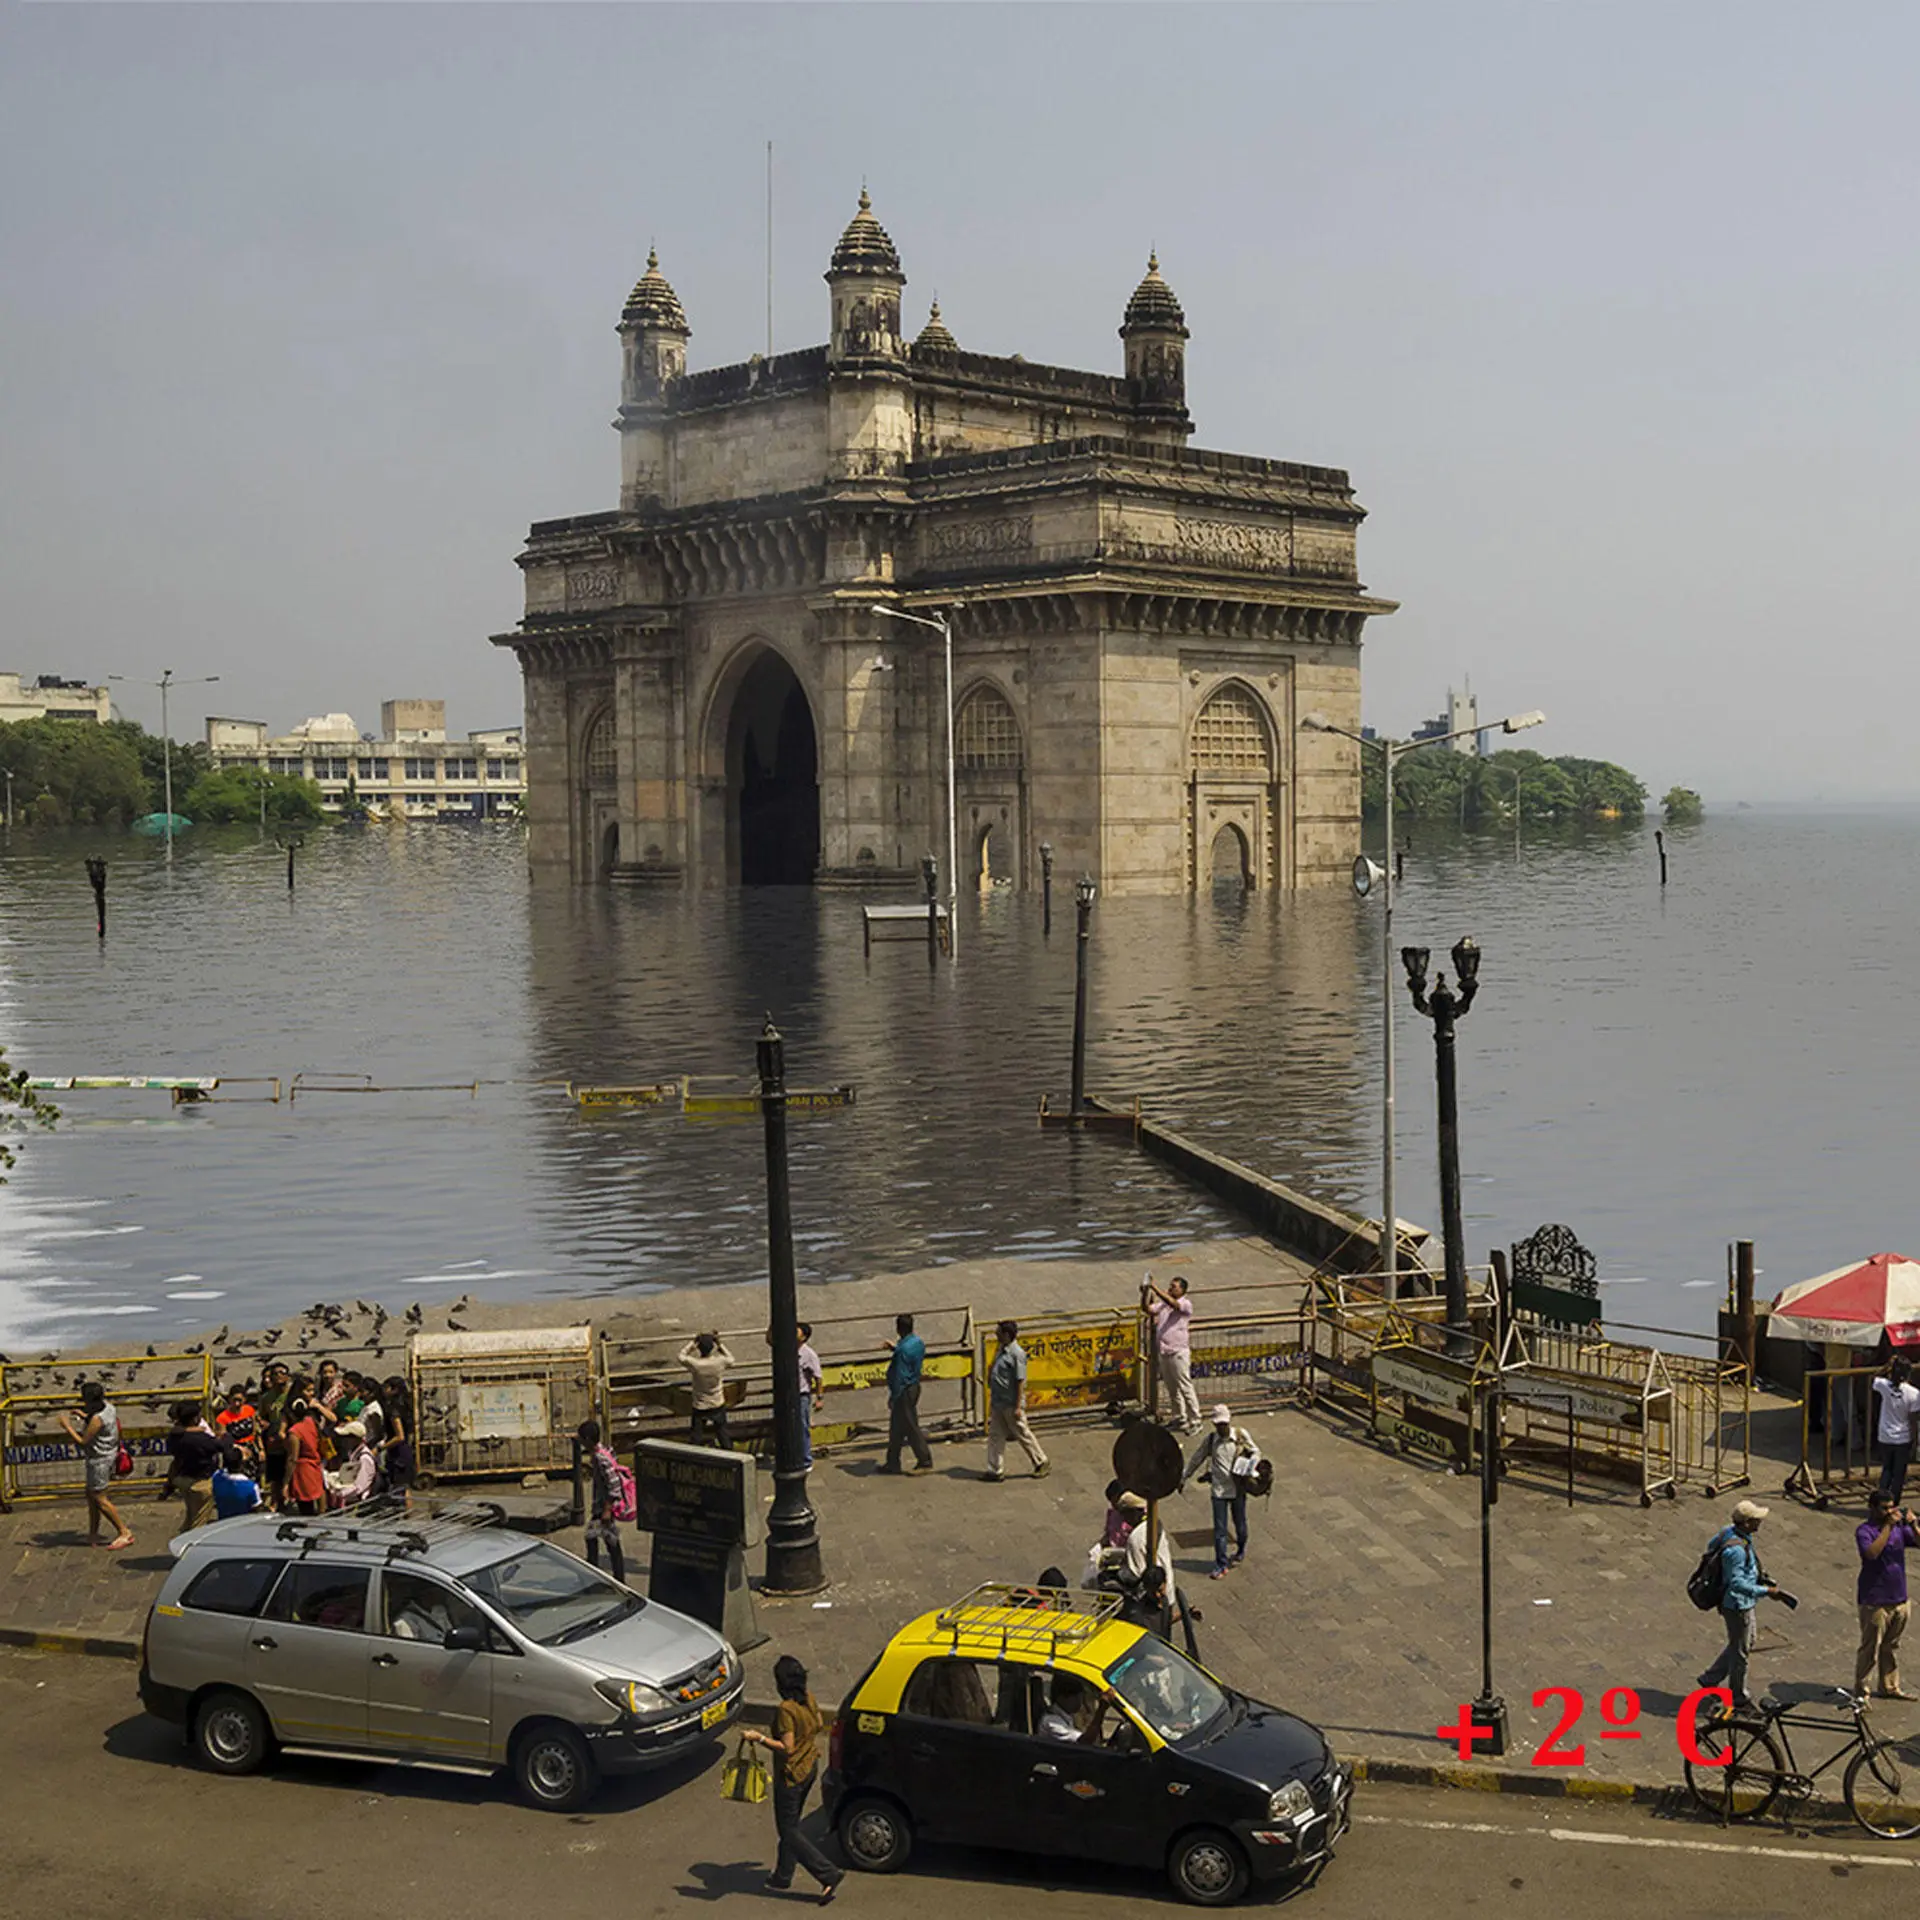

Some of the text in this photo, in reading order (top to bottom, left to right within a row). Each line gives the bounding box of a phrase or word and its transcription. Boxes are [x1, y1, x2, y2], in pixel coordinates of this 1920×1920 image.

[839, 1366, 887, 1382] Mumb
[1394, 1422, 1446, 1452] KUONI
[4, 1444, 68, 1466] MUMBAI
